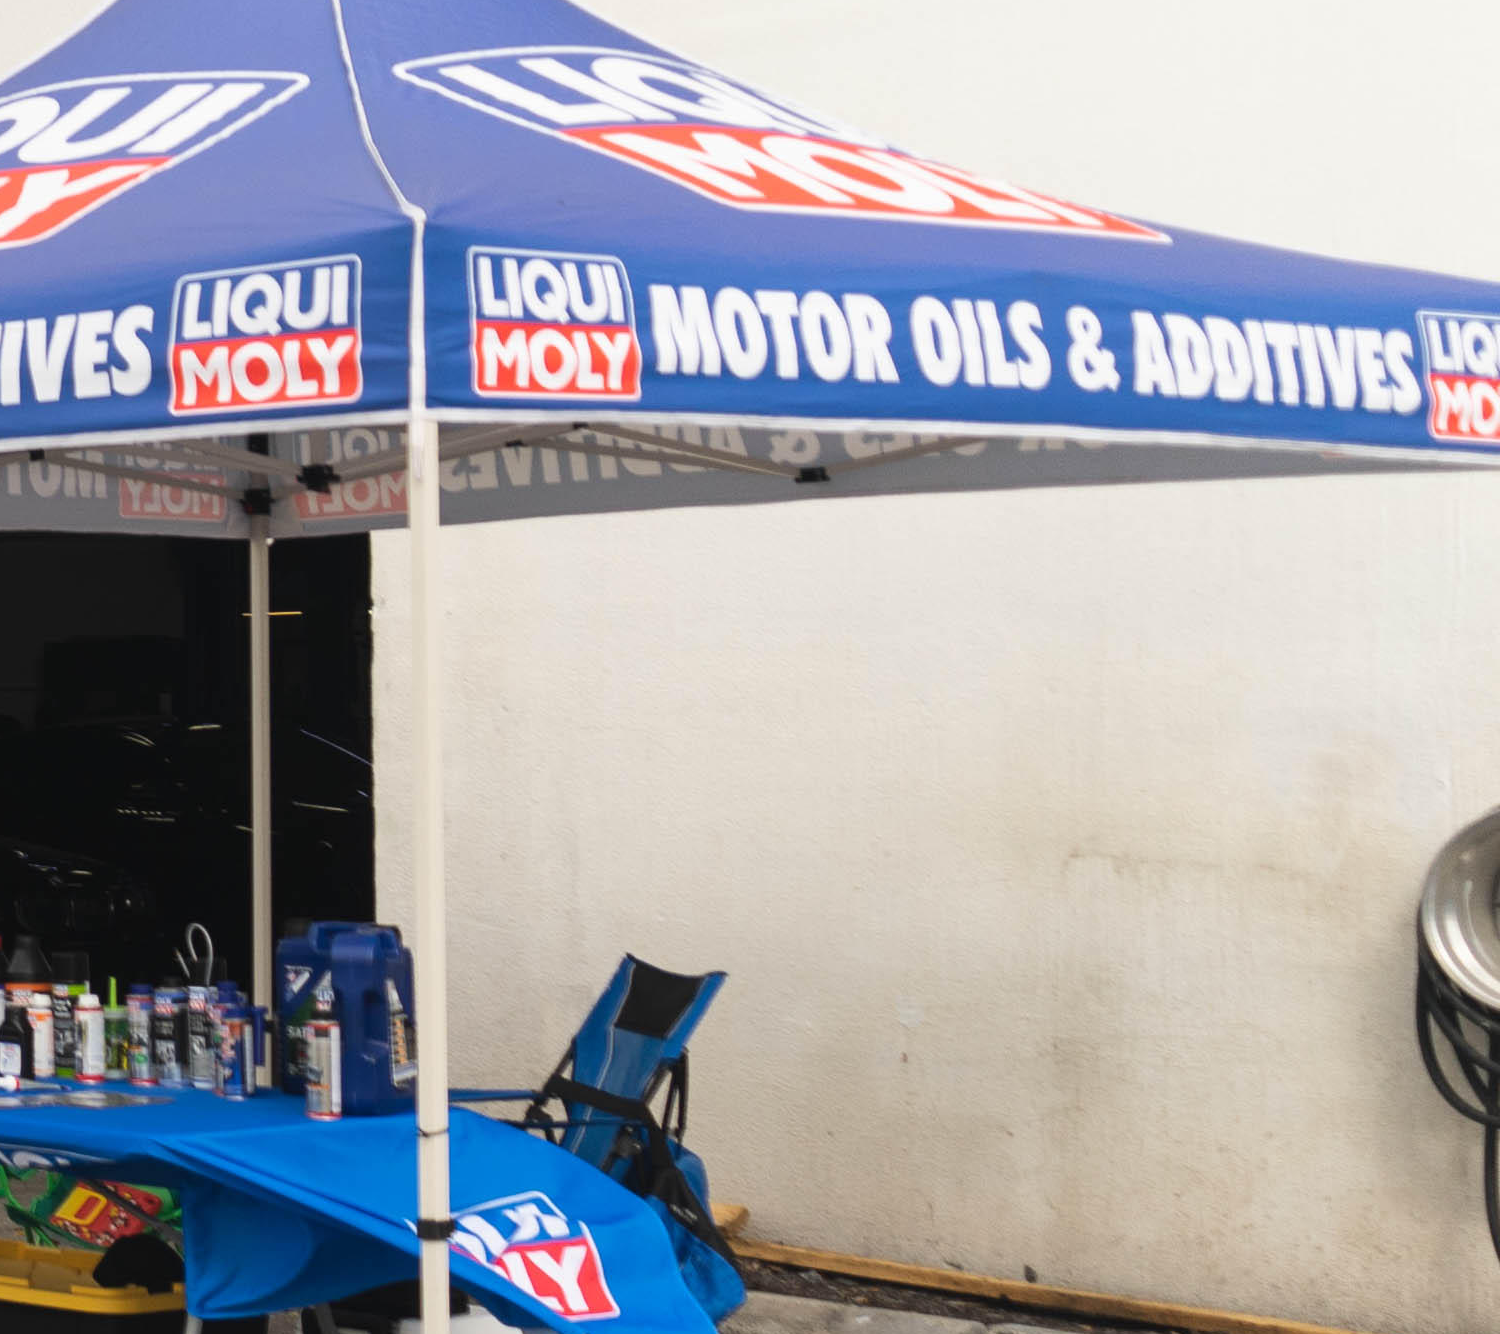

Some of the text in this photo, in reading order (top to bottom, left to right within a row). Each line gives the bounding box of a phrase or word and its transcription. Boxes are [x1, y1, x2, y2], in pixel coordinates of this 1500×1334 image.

[182, 264, 350, 338] LIQUI
[477, 255, 626, 325] LIQUI
[178, 334, 356, 407] MOLY
[480, 325, 633, 392] MOLY
[649, 284, 1422, 416] MOTOR OILS & ADDITIVES
[1426, 318, 1500, 378] LIQ
[1436, 378, 1500, 437] MO
